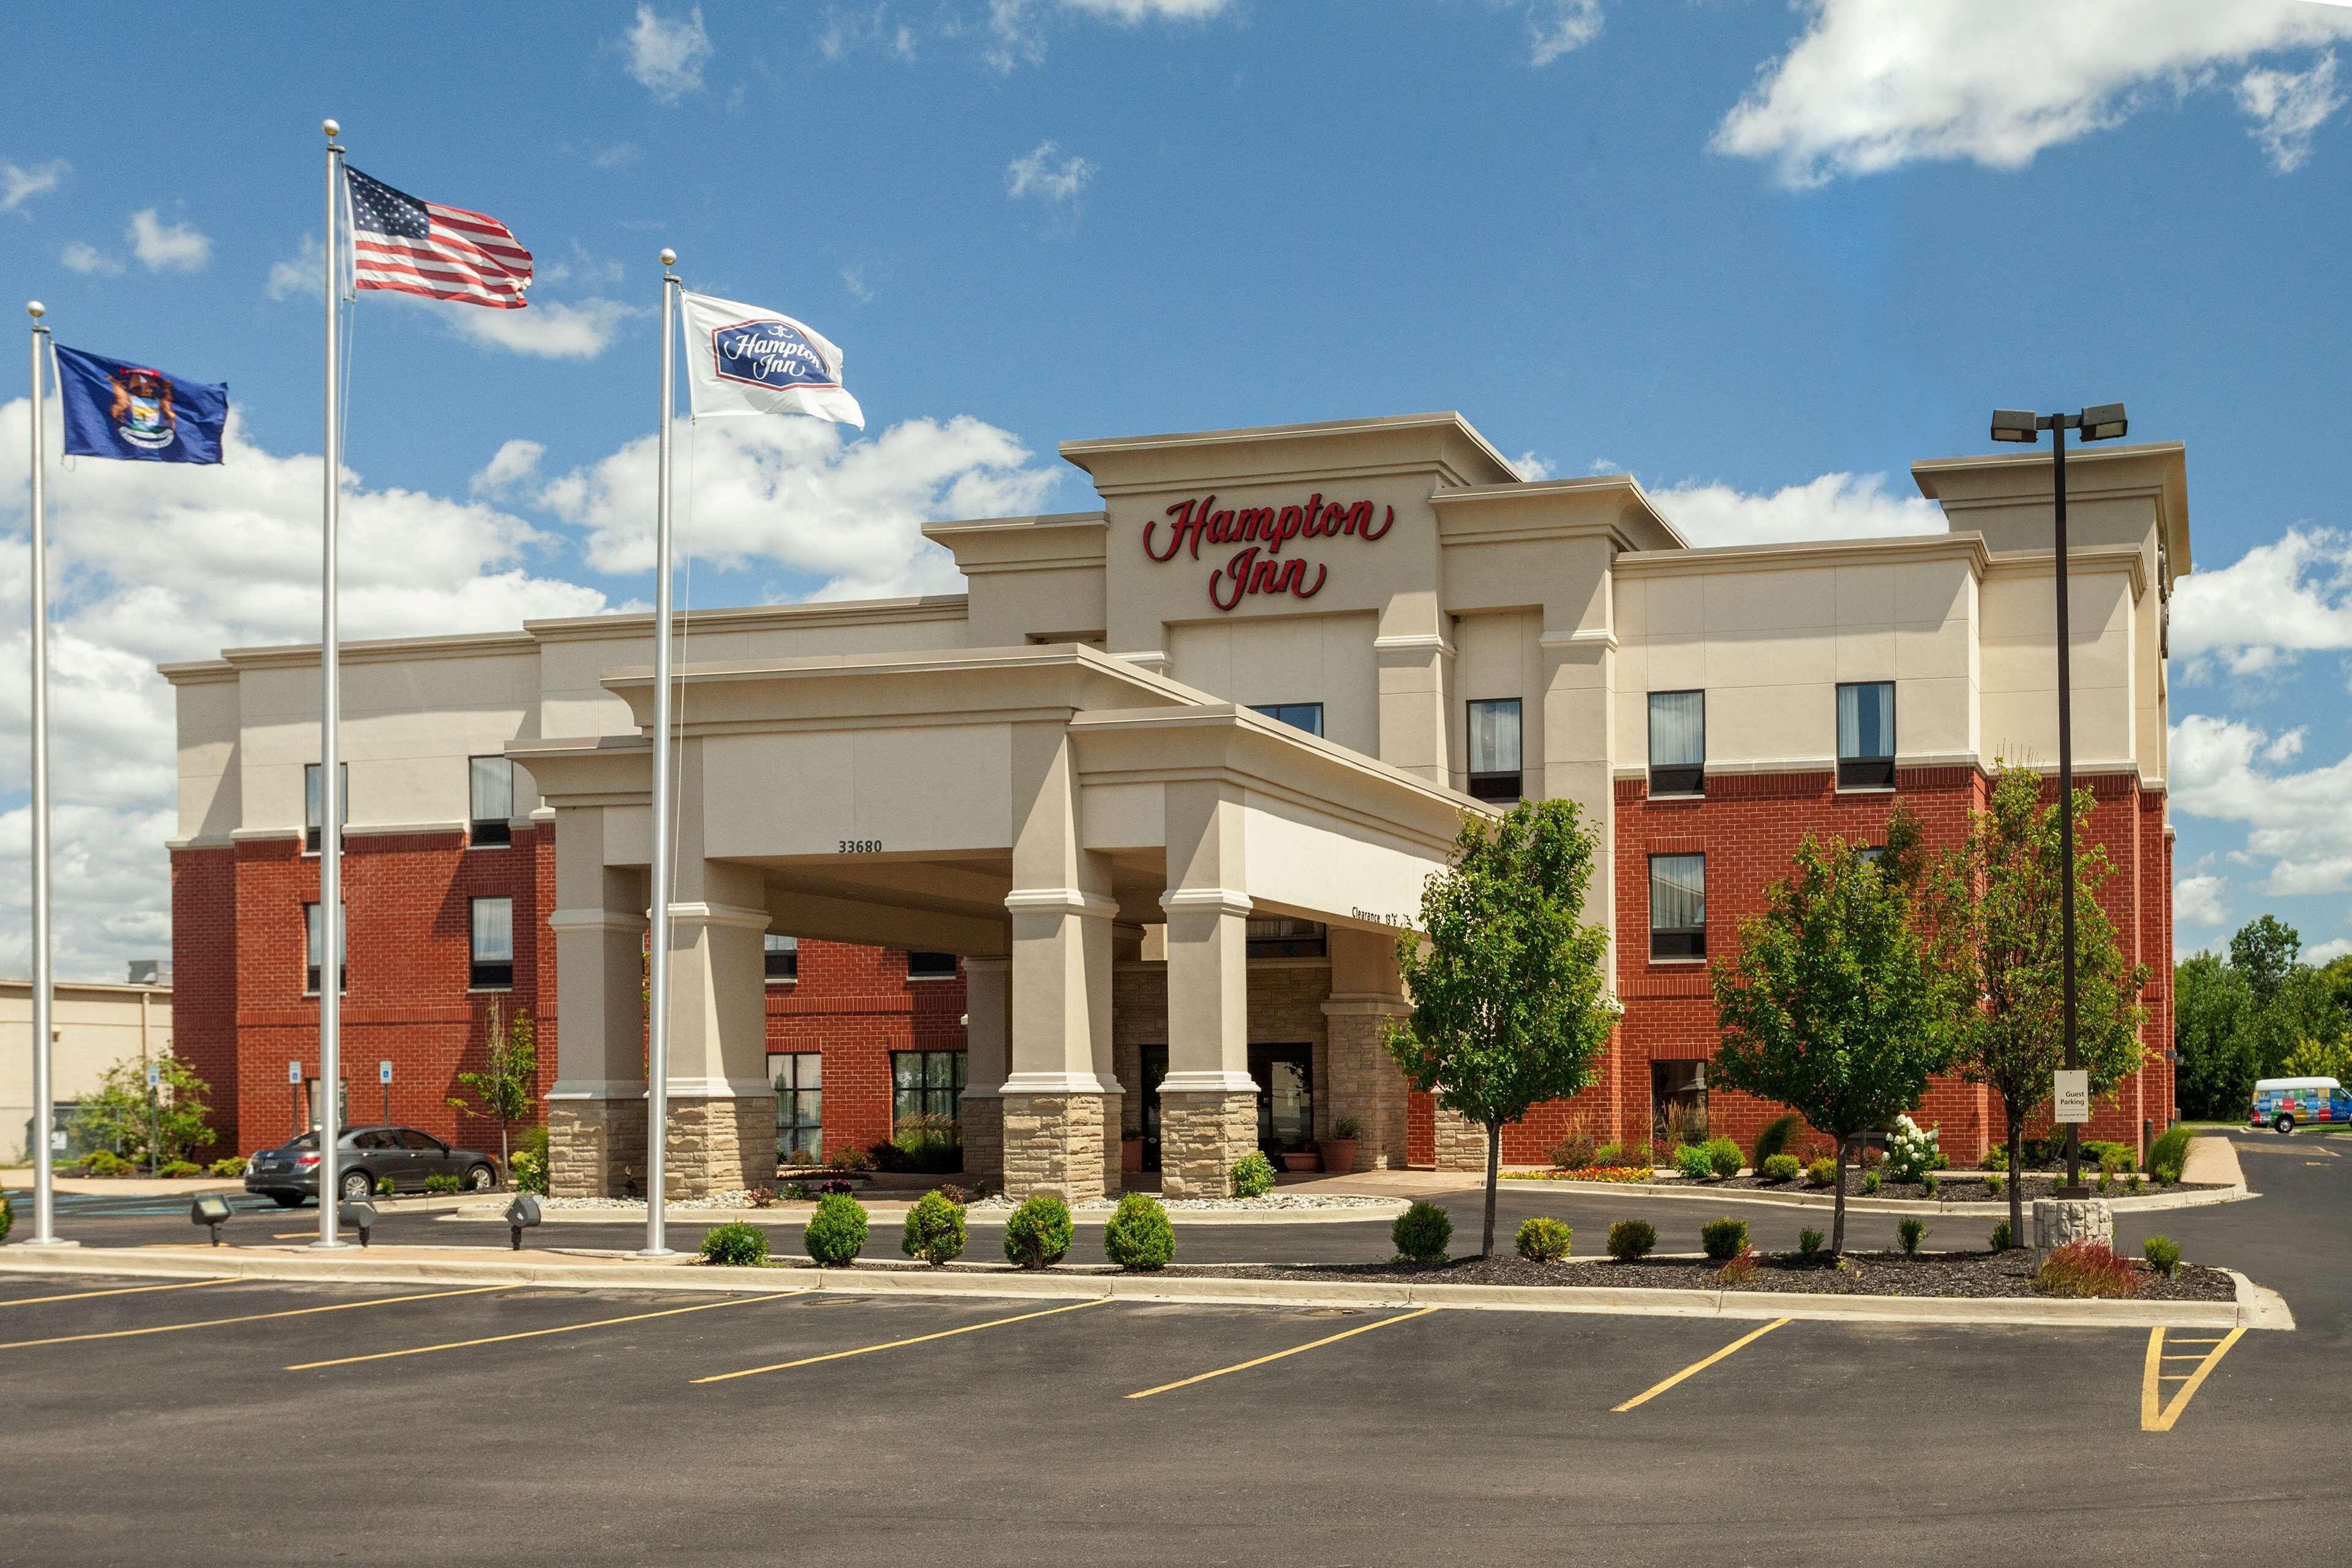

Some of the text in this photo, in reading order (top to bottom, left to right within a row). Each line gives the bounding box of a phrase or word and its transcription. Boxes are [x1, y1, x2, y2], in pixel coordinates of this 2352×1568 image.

[724, 333, 824, 372] Hampton
[753, 354, 805, 379] Inn
[1143, 493, 1394, 562] Hampton
[1209, 547, 1327, 611] Inn
[839, 840, 881, 853] 33680
[1352, 907, 1380, 922] Clearance
